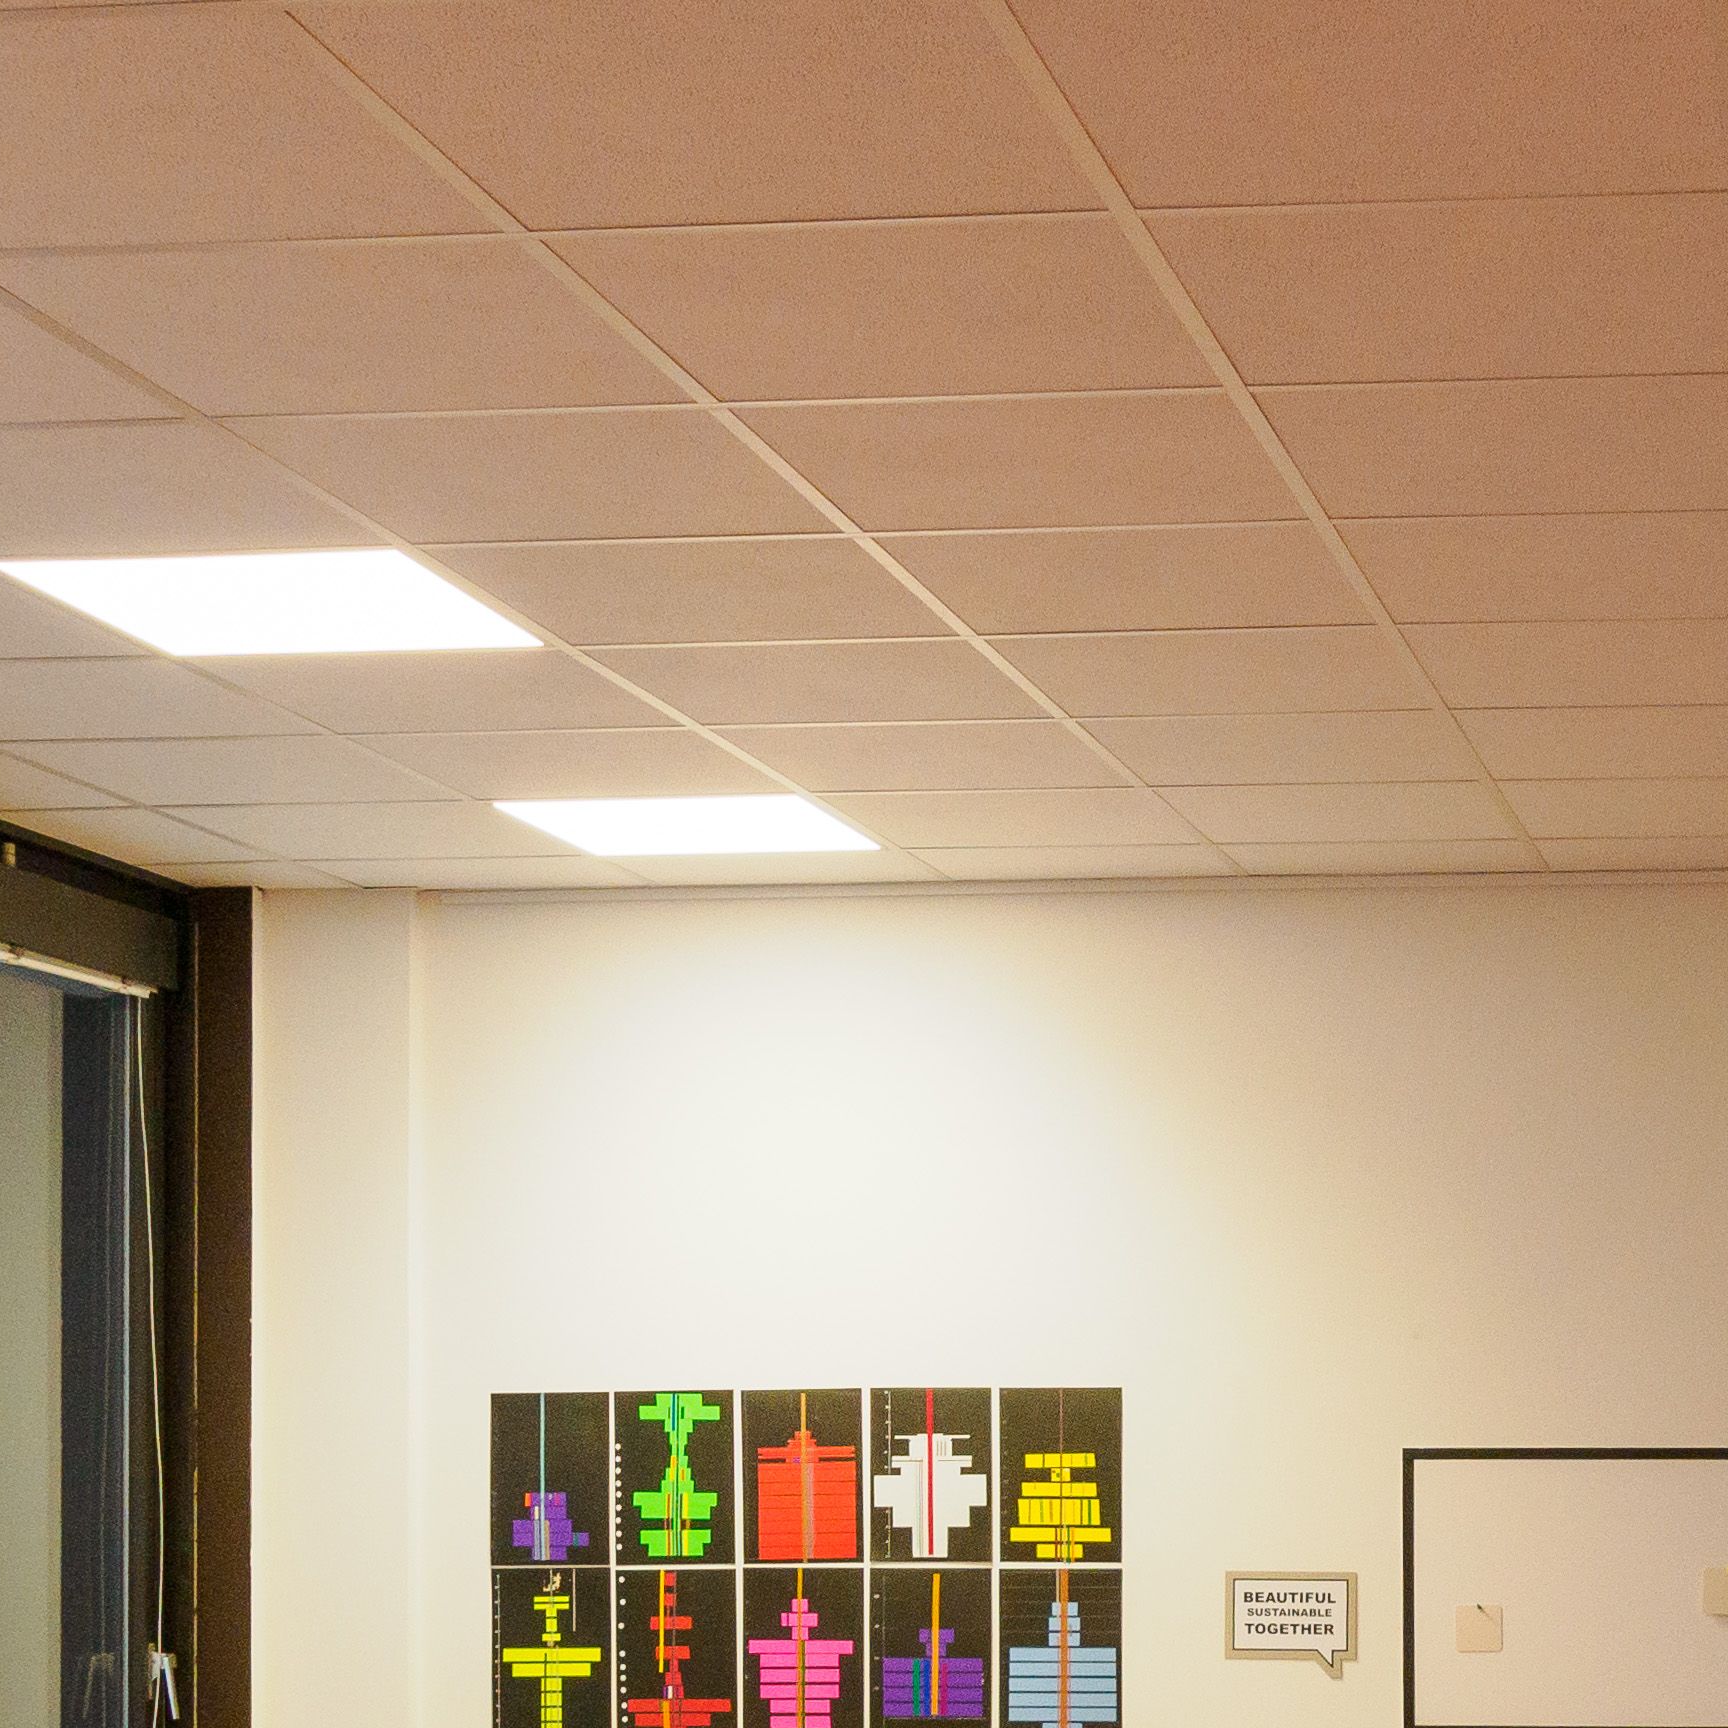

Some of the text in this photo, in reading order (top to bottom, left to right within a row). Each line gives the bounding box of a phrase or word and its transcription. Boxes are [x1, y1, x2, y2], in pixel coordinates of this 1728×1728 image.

[1243, 1591, 1336, 1603] BEAUTIFUL
[1247, 1608, 1332, 1617] SUSTAINABLE
[1245, 1623, 1334, 1635] TOGETHER
